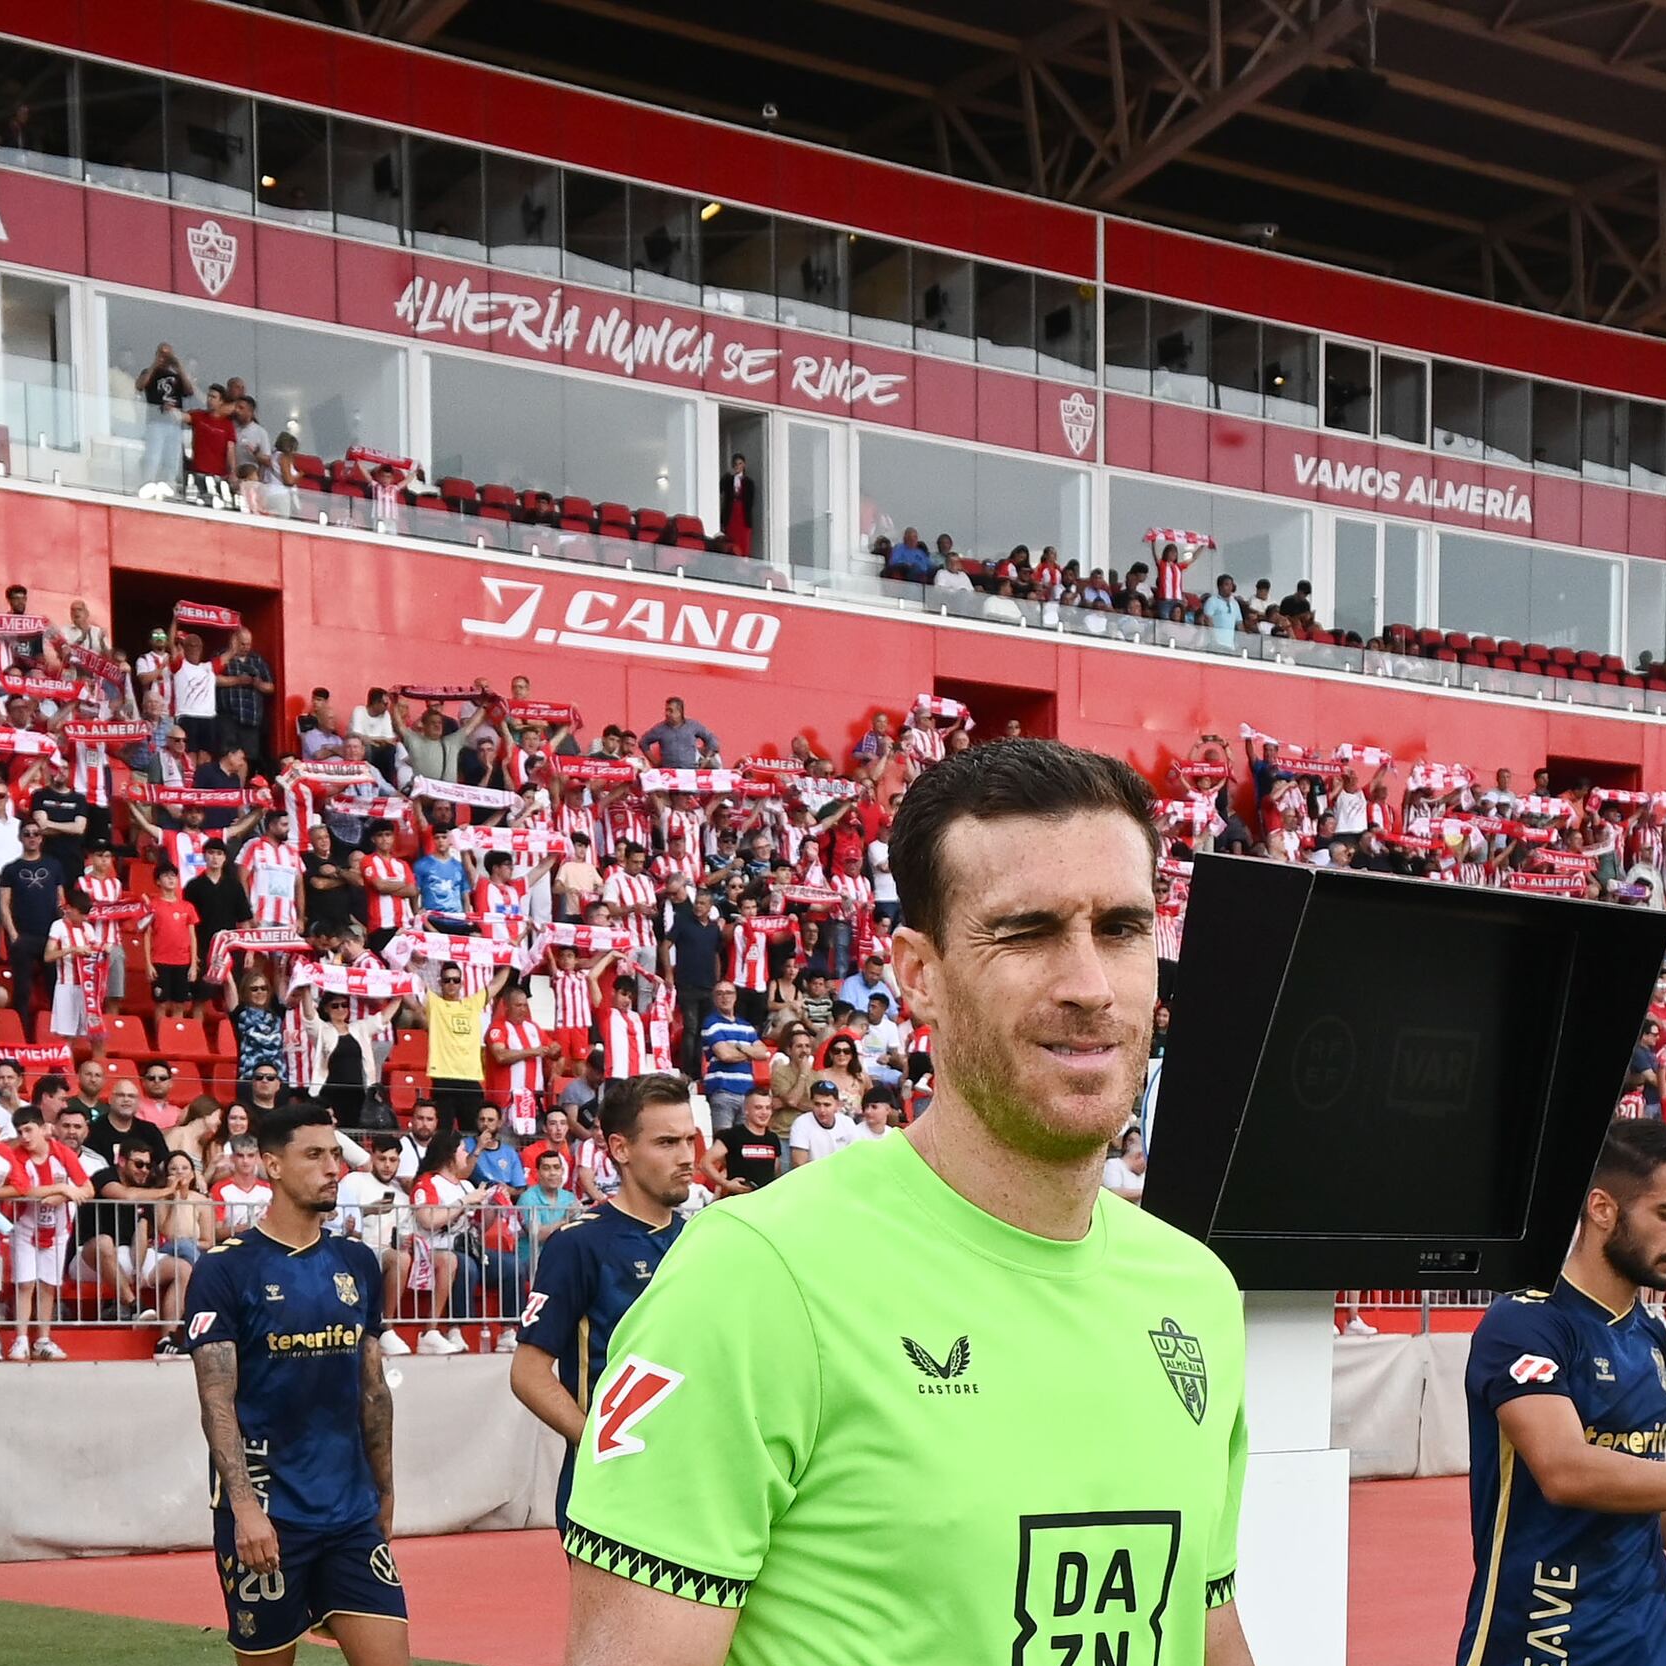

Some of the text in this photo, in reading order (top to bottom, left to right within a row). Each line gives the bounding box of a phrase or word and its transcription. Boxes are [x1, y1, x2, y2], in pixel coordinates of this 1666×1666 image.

[394, 275, 909, 406] ALMERÍA NUNCA SE RINDE
[1292, 450, 1533, 526] VAMOS ALMERÍA
[1157, 1338, 1197, 1355] U D
[1165, 1359, 1203, 1375] ALMERIA
[918, 1383, 980, 1395] CASTORE
[1053, 1549, 1137, 1617] DA
